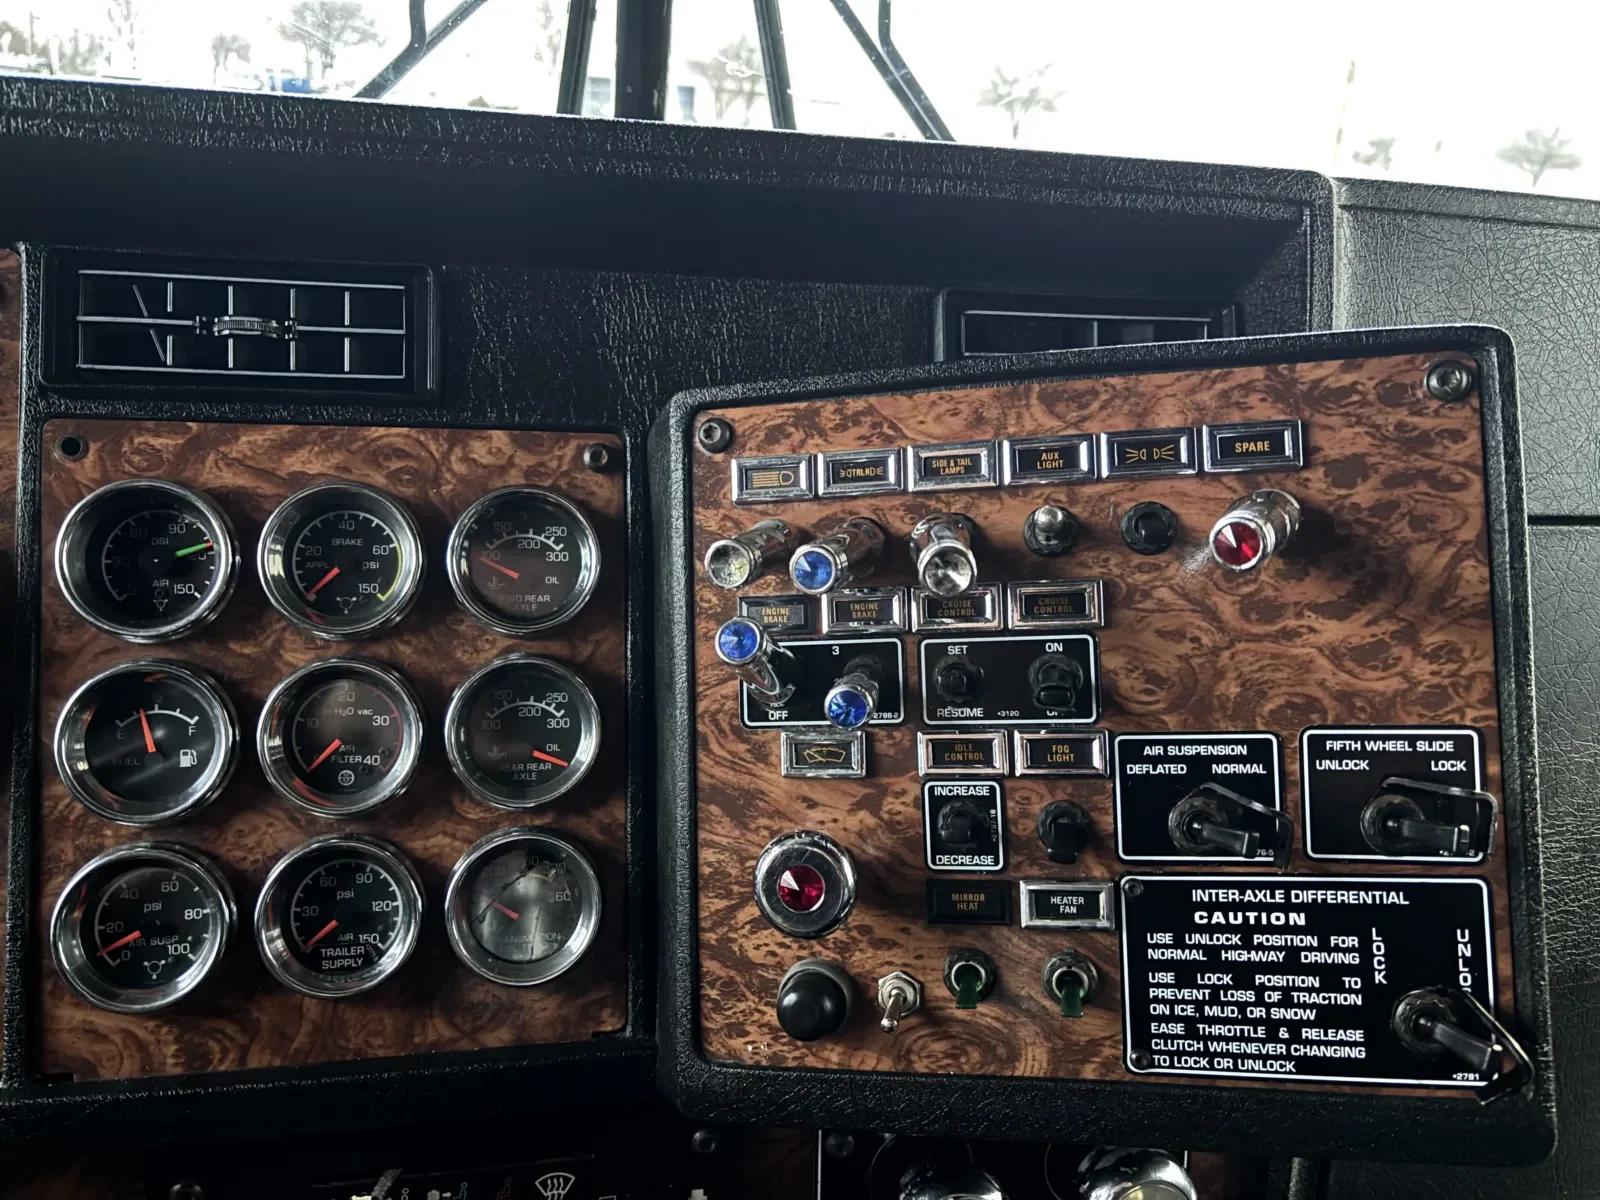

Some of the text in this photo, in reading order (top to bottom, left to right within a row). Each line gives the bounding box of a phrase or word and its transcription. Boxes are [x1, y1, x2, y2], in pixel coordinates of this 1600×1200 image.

[1235, 441, 1270, 453] SPARE
[1041, 451, 1060, 460] AUX
[932, 457, 972, 468] SIDE & TAIL
[1037, 459, 1064, 469] LIGHT
[940, 466, 965, 476] LAMPS
[168, 523, 186, 534] 90
[338, 520, 355, 531] 40
[545, 526, 567, 537] 250
[332, 537, 363, 546] BRAKE
[517, 539, 541, 549] 200
[305, 546, 322, 556] 20
[372, 545, 389, 555] 60
[545, 552, 569, 562] 300
[363, 560, 379, 570] psi
[152, 579, 169, 587] AIR
[545, 576, 560, 585] OIL
[173, 583, 195, 595] 150
[358, 583, 379, 594] 150
[524, 594, 551, 603] REAR
[942, 598, 972, 608] CRUISE
[1039, 597, 1068, 605] CRUISE
[513, 603, 537, 611] AXLE
[761, 607, 790, 616] ENGINE
[850, 602, 879, 611] ENGINE
[937, 607, 976, 617] CONTROL
[1033, 605, 1074, 614] CONTROL
[763, 615, 788, 624] BRAKE
[852, 610, 876, 619] BRAKE
[831, 645, 840, 656] 3
[947, 645, 968, 655] SET
[1045, 642, 1063, 652] ON
[546, 692, 568, 703] 250
[518, 706, 541, 717] 200
[768, 710, 788, 721] OFF
[937, 708, 984, 718] RESUME
[307, 718, 319, 728] 10
[372, 715, 390, 726] 30
[482, 720, 501, 730] 100
[546, 718, 570, 728] 300
[116, 728, 125, 740] E
[188, 726, 197, 736] F
[546, 743, 561, 752] OIL
[954, 744, 973, 752] IDLE
[1052, 745, 1069, 753] FOG
[1143, 745, 1247, 756] AIR SUSPENSION
[1325, 740, 1454, 752] FIFTH WHEEL SLIDE
[331, 755, 362, 764] FILTER
[363, 755, 381, 766] 40
[945, 751, 985, 761] CONTROL
[1047, 753, 1074, 763] LIGHT
[112, 758, 139, 766] FUEL
[526, 762, 552, 771] REAR
[1315, 759, 1370, 770] UNLOCK
[1431, 760, 1467, 771] LOCK
[1126, 764, 1187, 774] DEFLATED
[1211, 763, 1267, 774] NORMAL
[512, 772, 537, 781] AXLE
[934, 785, 990, 797] INCREASE
[936, 855, 995, 866] DECREASE
[319, 876, 337, 887] 60
[355, 873, 373, 884] 90
[161, 881, 179, 892] 60
[120, 888, 138, 900] 40
[337, 888, 354, 900] psi
[951, 892, 985, 902] MIRROR
[1192, 889, 1409, 904] INTER-AXLE DIFFERENTIAL
[372, 900, 392, 912] 120
[1050, 896, 1084, 905] HEATER
[143, 900, 162, 913] psi
[302, 906, 319, 917] 30
[956, 902, 979, 911] HEAT
[1059, 905, 1077, 914] FAN
[184, 908, 203, 920] 80
[1194, 911, 1306, 926] CAUTION
[105, 921, 124, 932] 20
[150, 935, 179, 946] SUSP
[337, 933, 354, 941] AIR
[359, 933, 380, 944] 150
[1147, 933, 1359, 948] USE UNLOCK POSITION FOR
[167, 943, 190, 955] 100
[320, 945, 365, 957] TRAILER
[121, 950, 131, 961] 0
[1148, 948, 1360, 965] NORMAL HIGHWAY DRIVING
[1371, 927, 1388, 985] LOCK
[1456, 928, 1472, 993] UNLO
[321, 957, 364, 969] SUPPLY
[1149, 972, 1362, 989] USE LOCK POSITION TO
[1149, 988, 1362, 1005] PREVENT LOSS OF TRACTION
[1150, 1004, 1316, 1020] ON ICE, MUD, OR SNOW
[1150, 1022, 1365, 1041] EASE THROTTLE & RELEASE
[1151, 1039, 1366, 1058] CLUTCH WHENEVER CHANGING
[1152, 1055, 1296, 1072] TO LOCK OR UNLOCK
